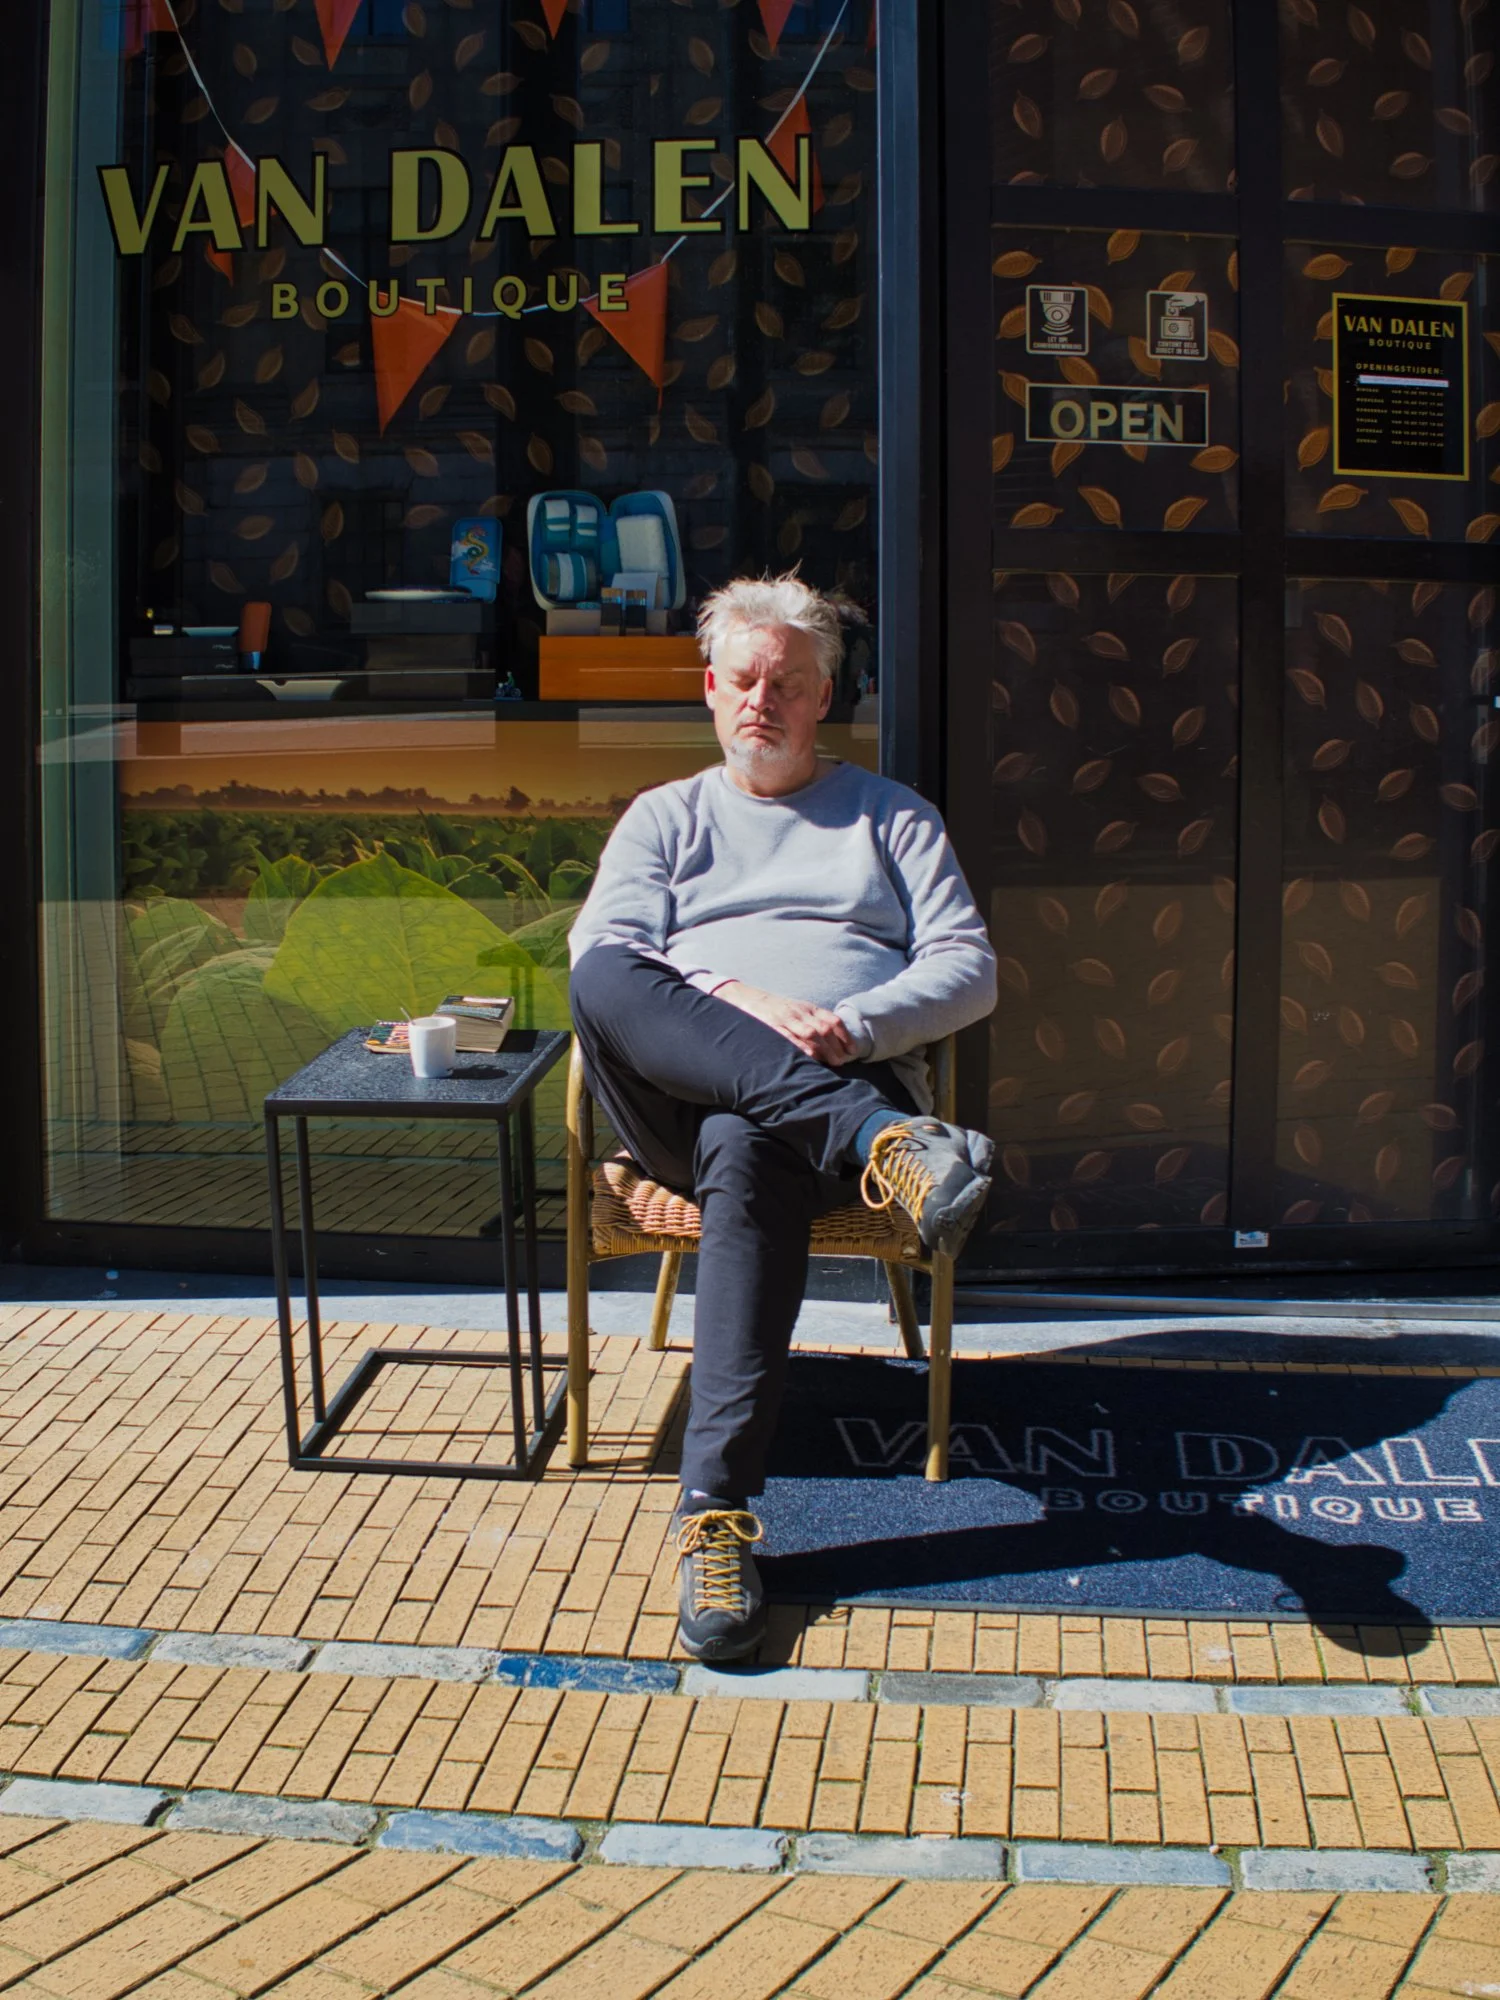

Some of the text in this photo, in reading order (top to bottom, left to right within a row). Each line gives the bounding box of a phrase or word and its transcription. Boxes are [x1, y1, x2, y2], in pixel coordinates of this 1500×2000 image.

[97, 135, 813, 257] VAN DALEN
[271, 273, 628, 319] BOUTIQUE
[1344, 315, 1455, 338] VAN DALEN
[1368, 338, 1432, 350] BOUTIQUE
[1050, 399, 1183, 441] OPEN
[834, 1417, 1117, 1478] VAN
[1040, 1487, 1485, 1525] BOUTIQUE
